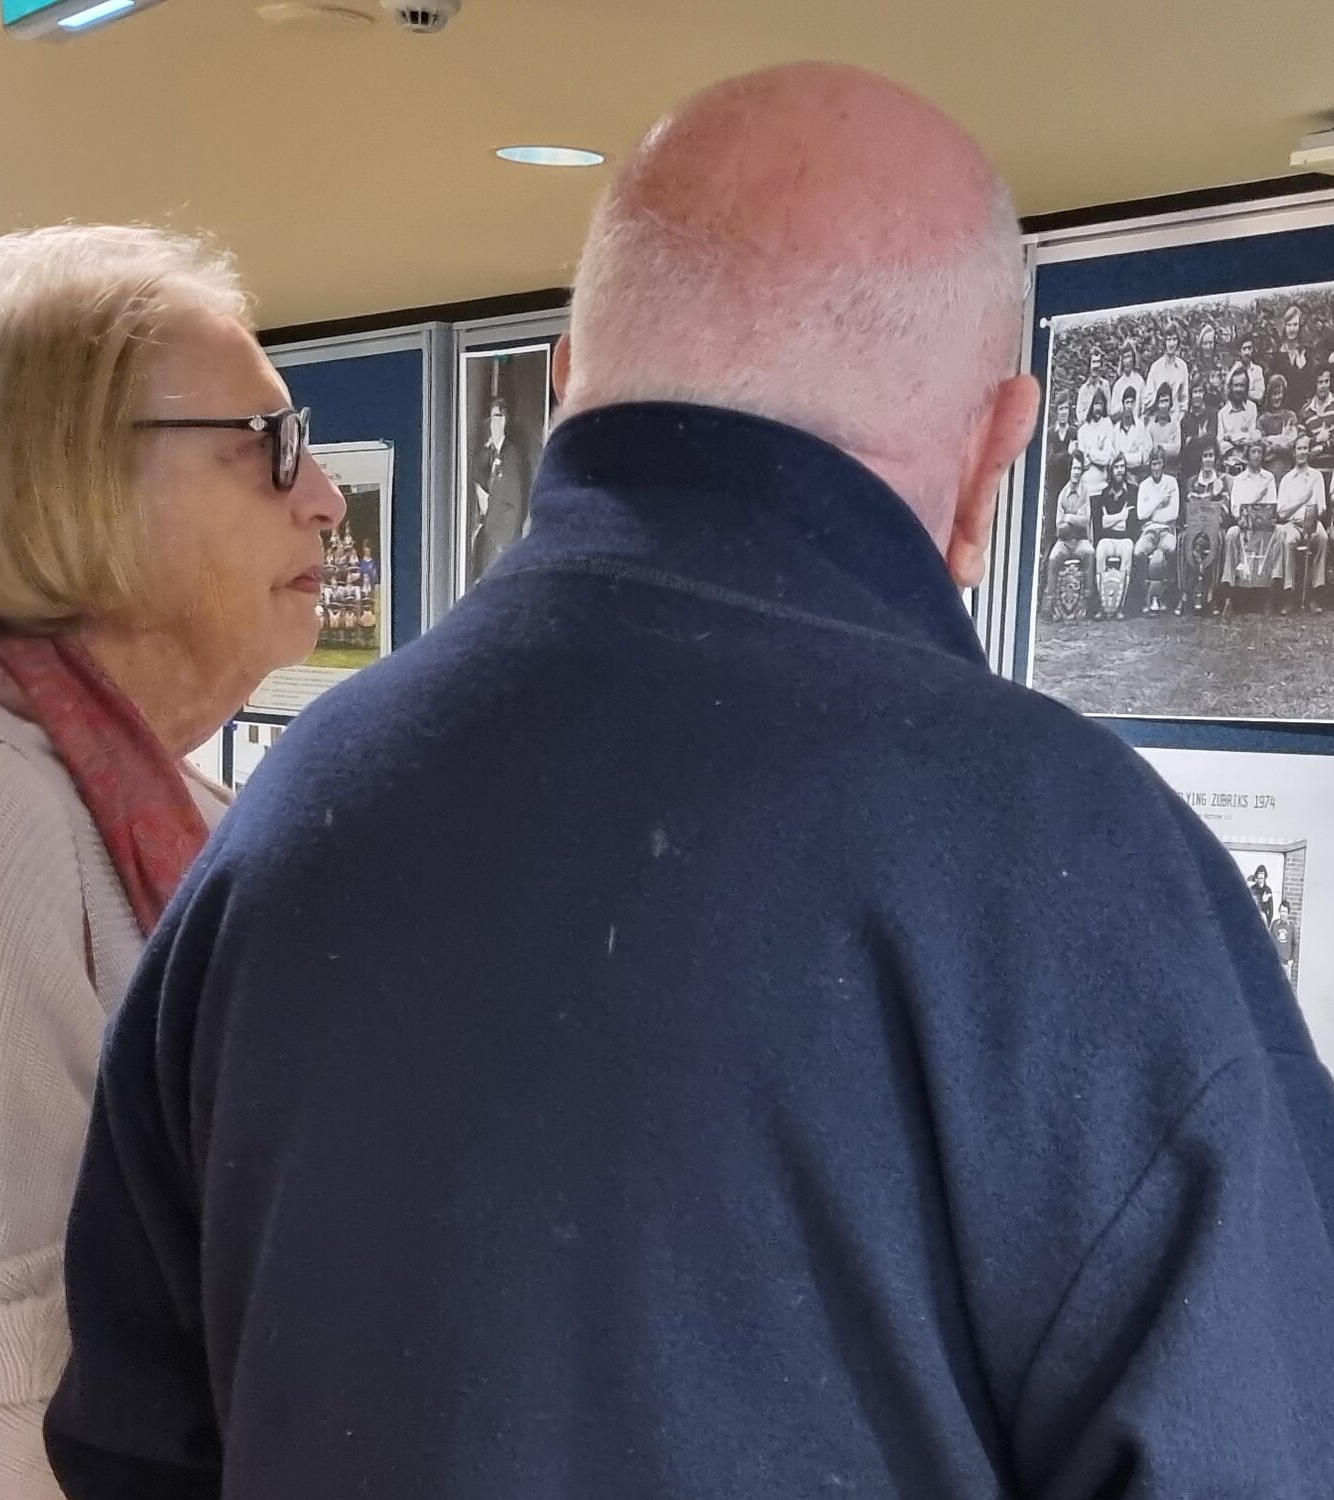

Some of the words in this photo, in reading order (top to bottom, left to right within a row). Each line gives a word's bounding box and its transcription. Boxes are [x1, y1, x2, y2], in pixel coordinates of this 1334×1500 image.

[1177, 791, 1207, 807] YING
[1211, 792, 1248, 809] ZUBRIKS
[1253, 794, 1276, 809] 1974
